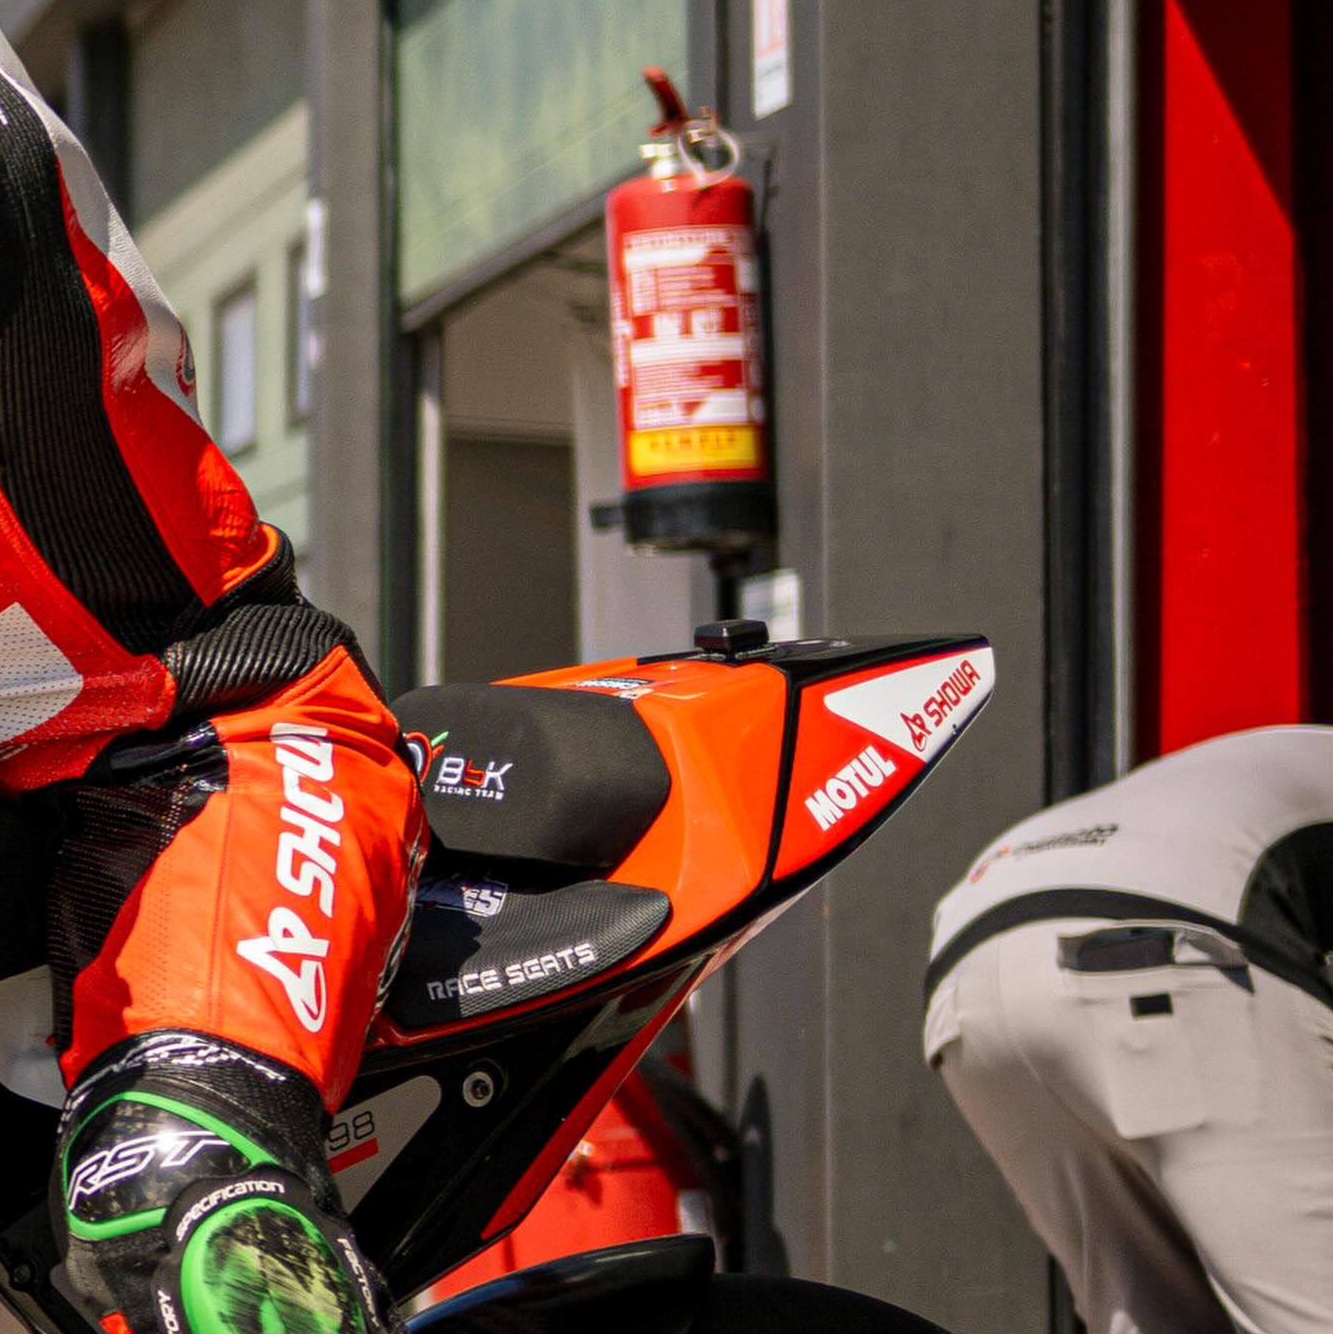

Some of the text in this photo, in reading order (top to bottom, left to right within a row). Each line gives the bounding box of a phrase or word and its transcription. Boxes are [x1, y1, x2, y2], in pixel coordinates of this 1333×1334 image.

[923, 659, 982, 728] SHOWA
[804, 745, 897, 832] MOTUL
[426, 942, 597, 1001] RACE SEATS
[69, 1130, 231, 1210] RST
